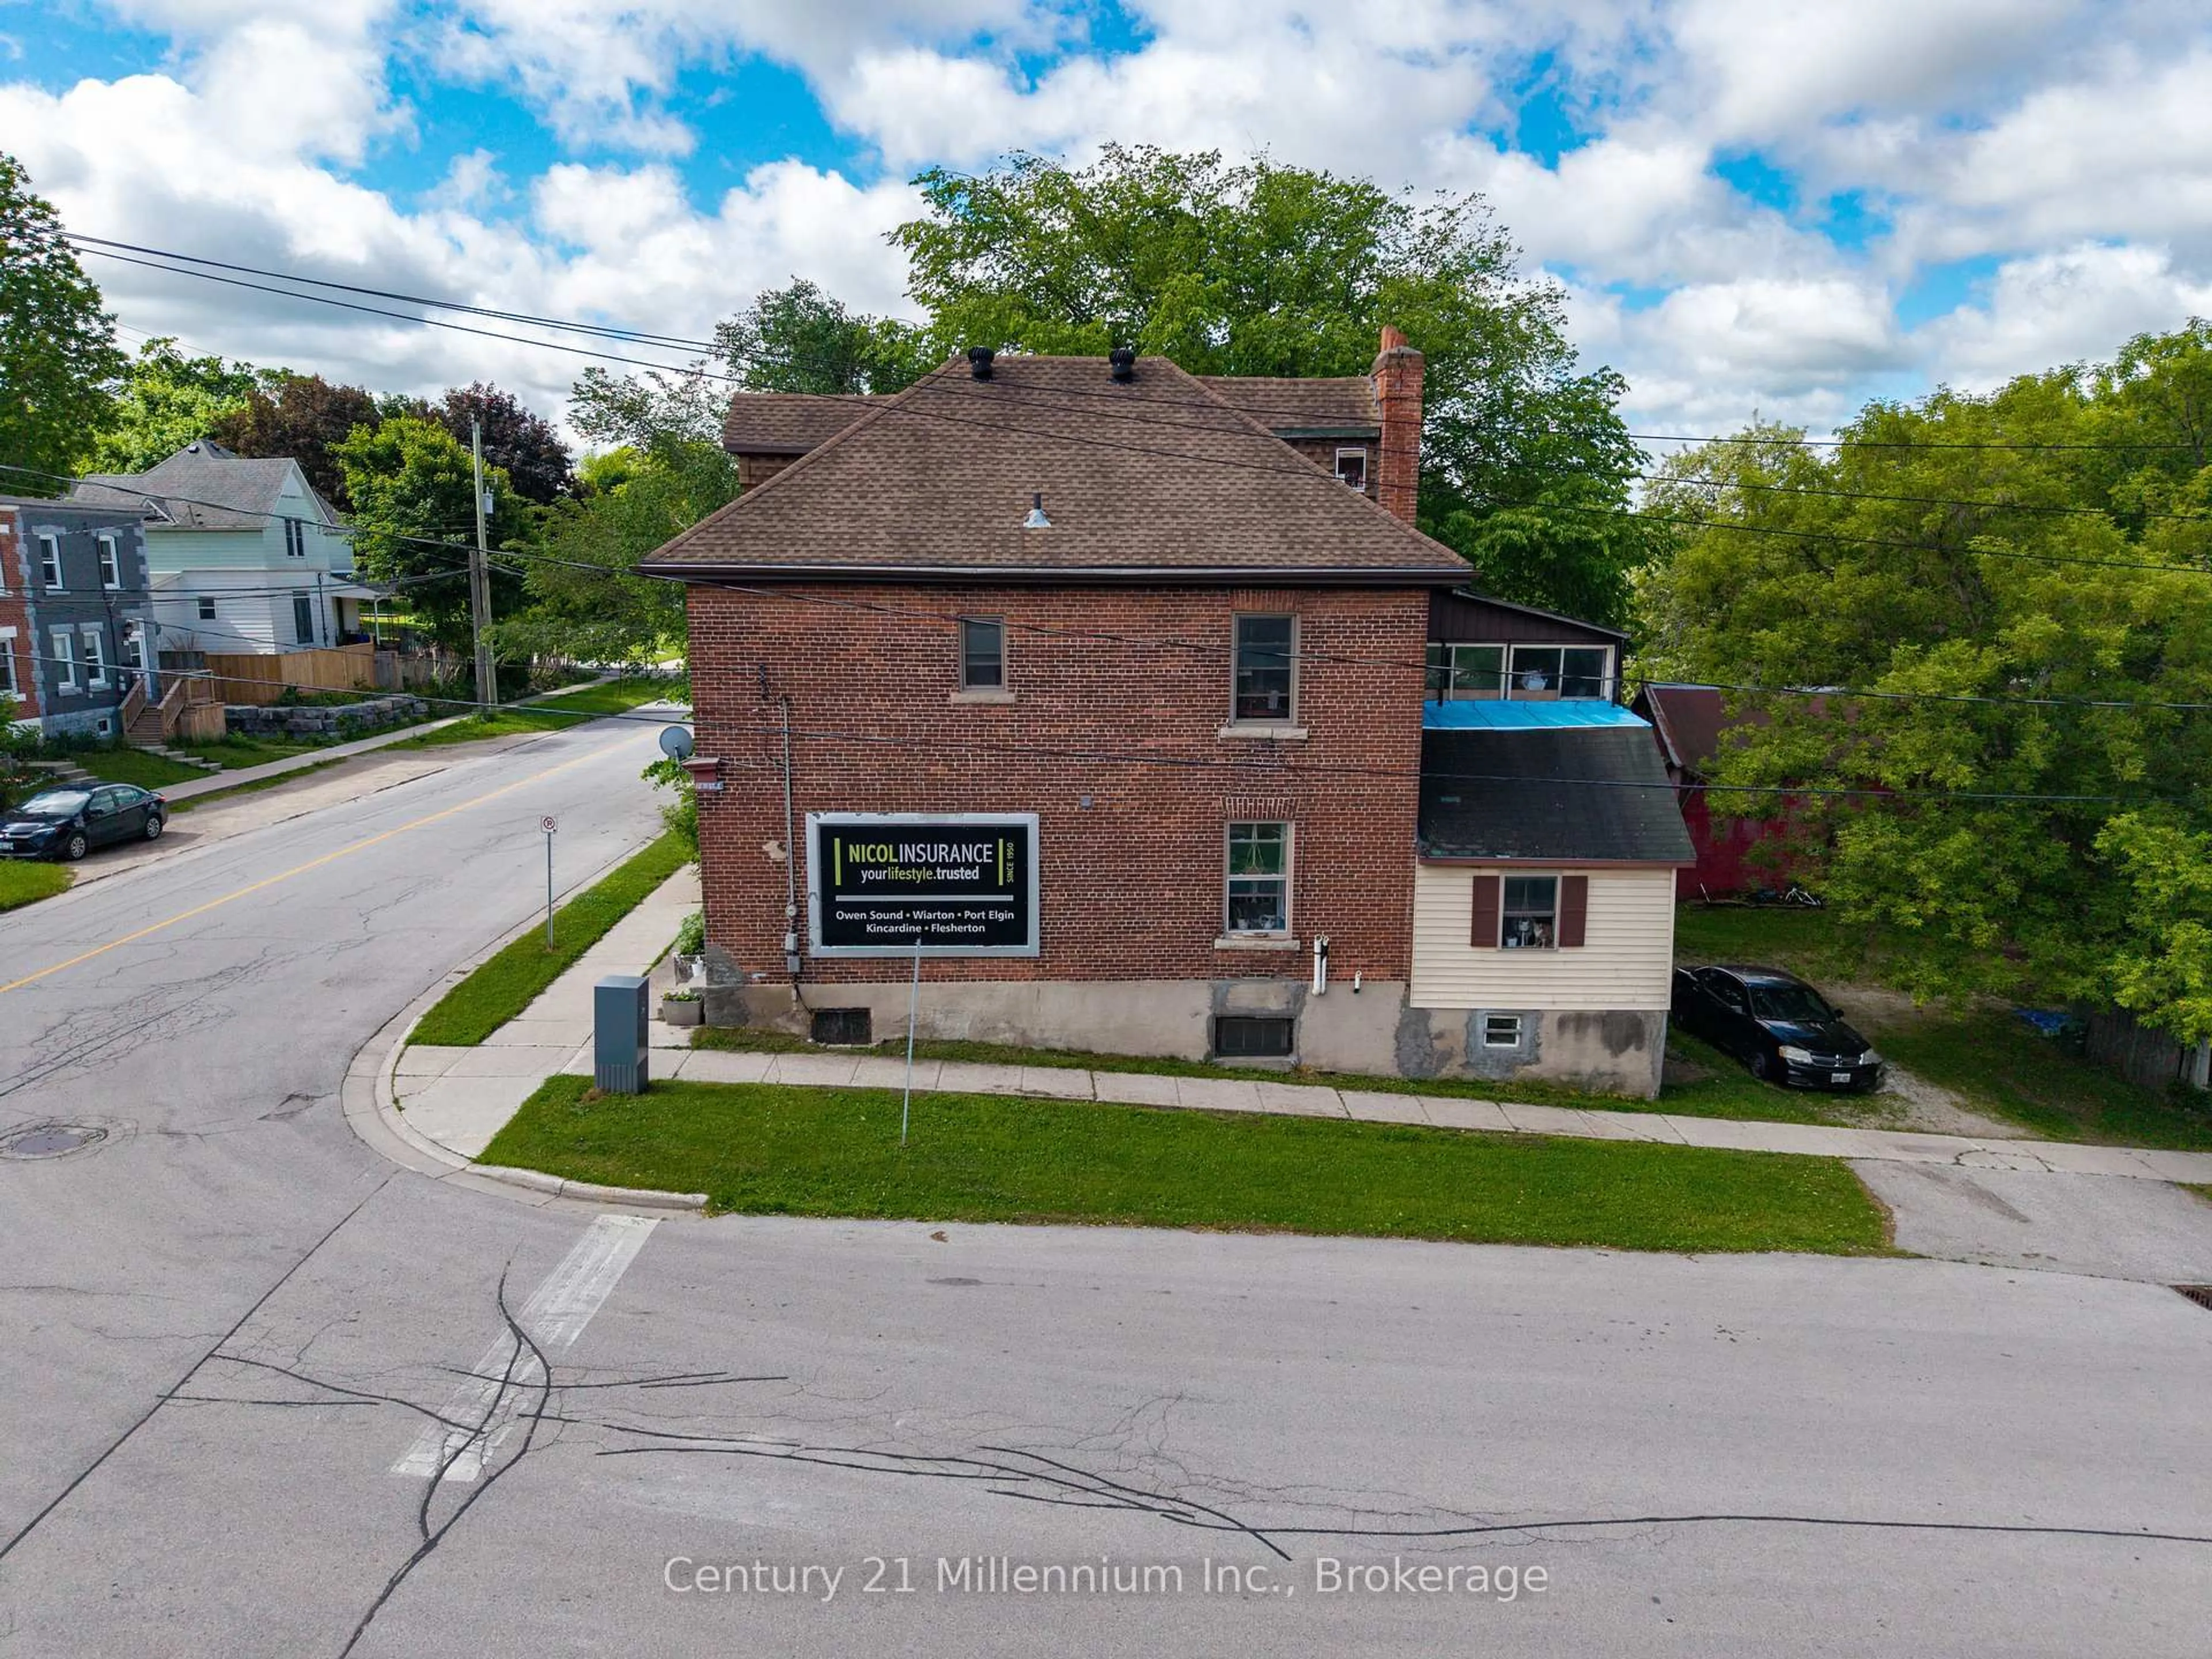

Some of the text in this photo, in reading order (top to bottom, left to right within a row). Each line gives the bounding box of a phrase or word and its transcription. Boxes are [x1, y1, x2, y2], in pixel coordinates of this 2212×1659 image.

[836, 910, 1014, 922] Owen Sound Wiarton Port Elgin
[866, 923, 986, 933] Kincardine Flesherton
